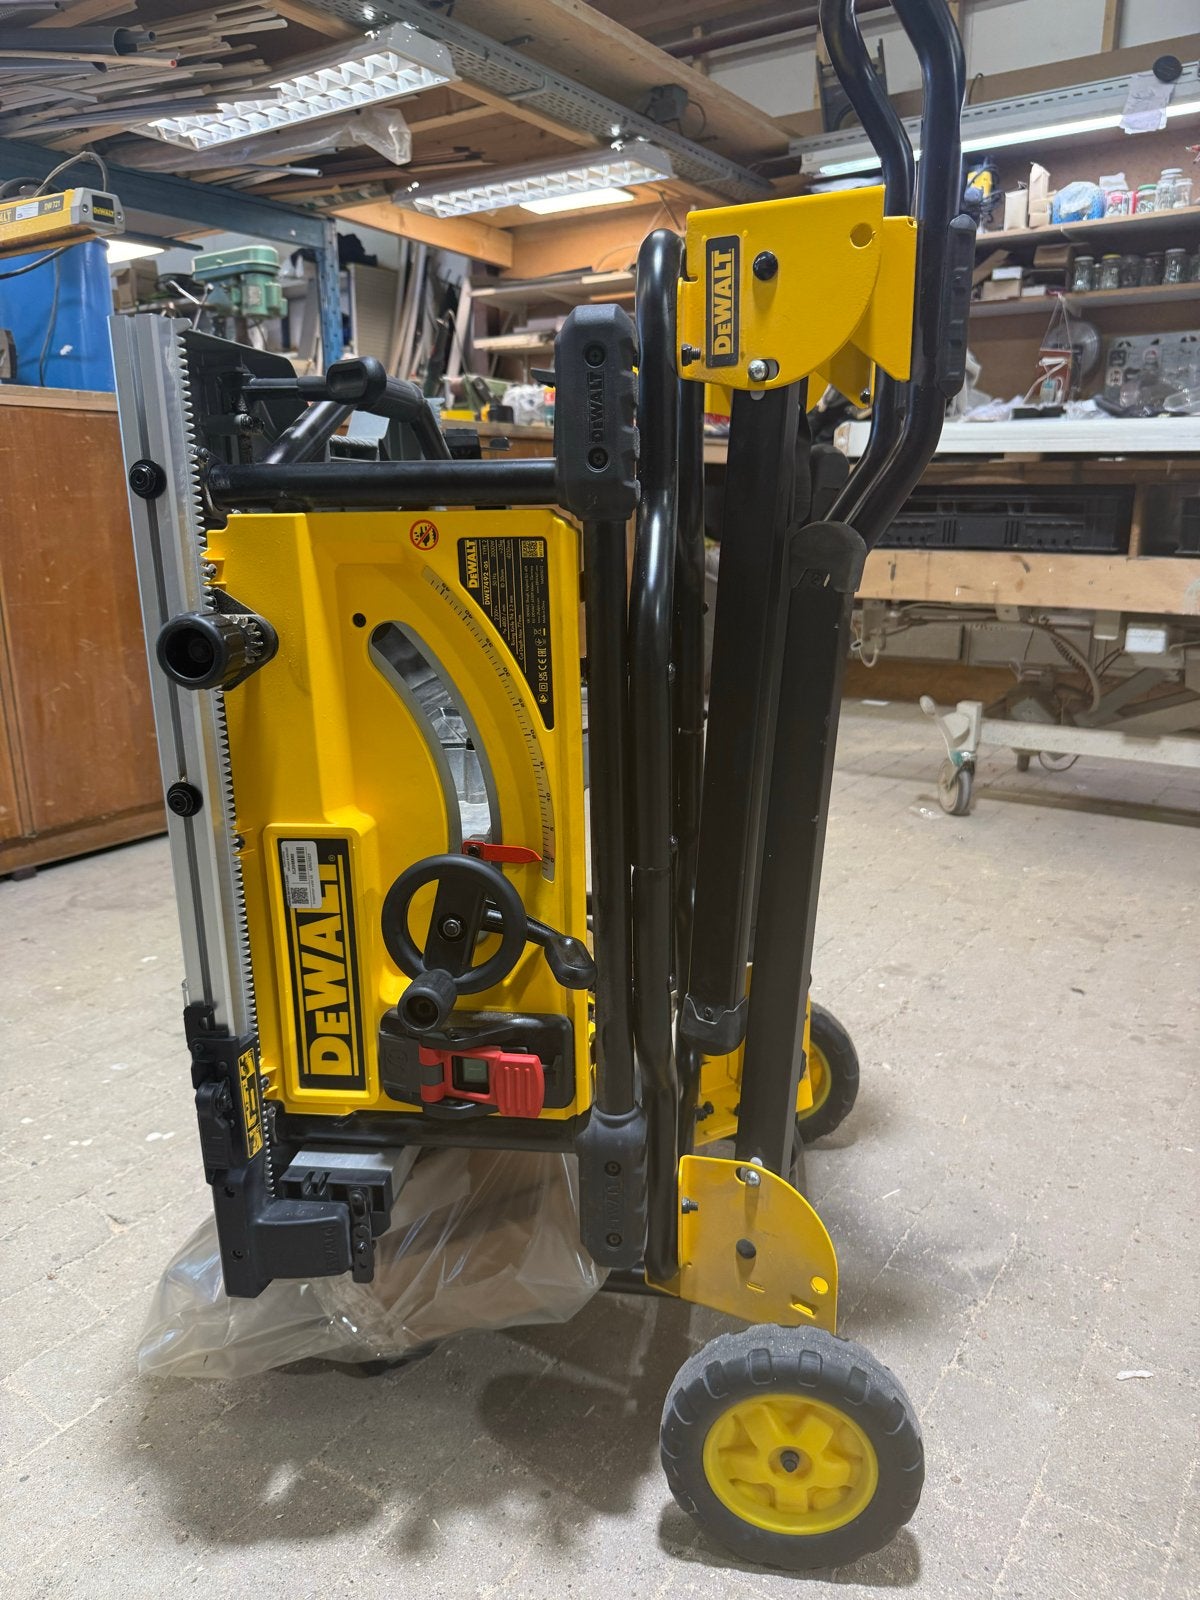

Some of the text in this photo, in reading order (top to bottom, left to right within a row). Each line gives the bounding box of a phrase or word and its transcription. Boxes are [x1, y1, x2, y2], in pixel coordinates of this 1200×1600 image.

[45, 202, 52, 210] DW
[93, 207, 114, 217] DEWALT
[713, 250, 731, 355] DEWALT
[588, 372, 603, 442] DEWALT
[467, 540, 478, 588] DEWALT
[503, 667, 510, 677] 30
[530, 729, 536, 739] 20
